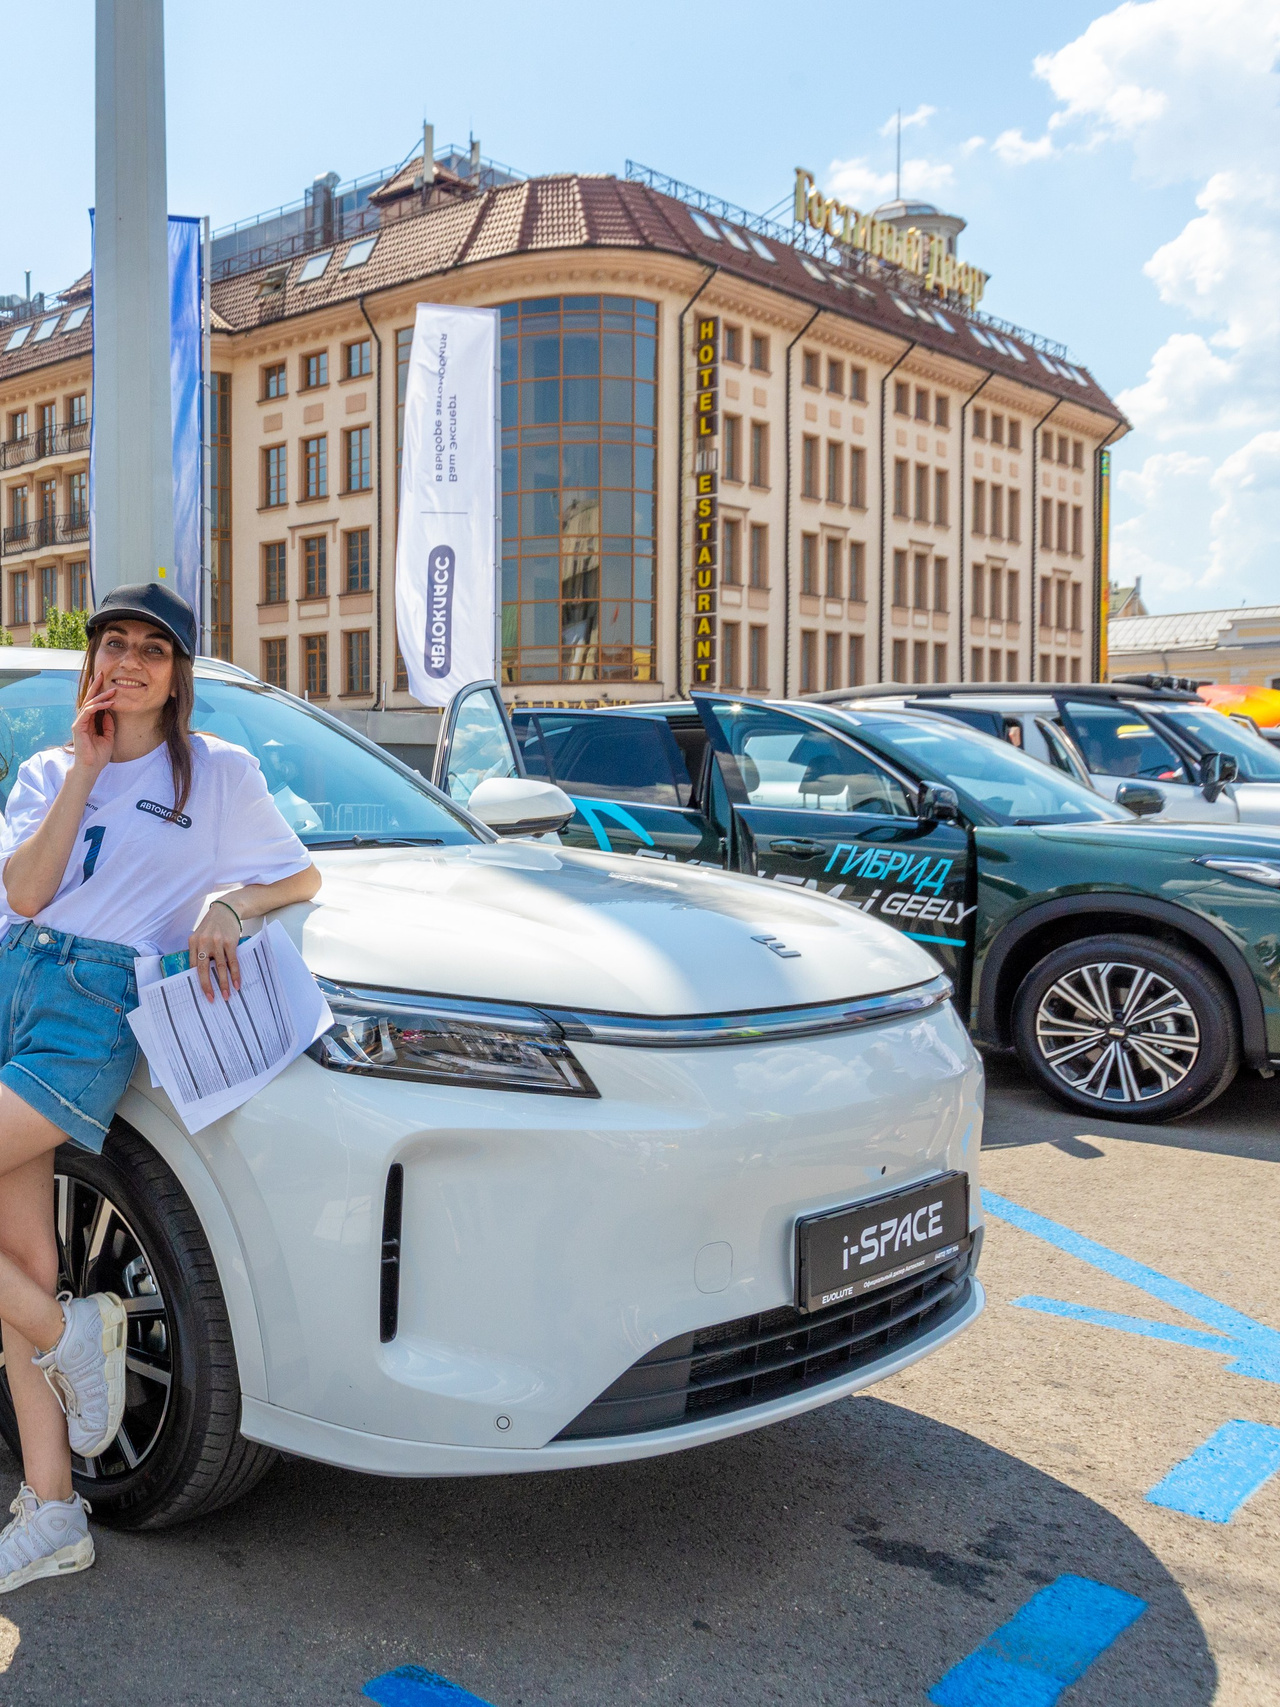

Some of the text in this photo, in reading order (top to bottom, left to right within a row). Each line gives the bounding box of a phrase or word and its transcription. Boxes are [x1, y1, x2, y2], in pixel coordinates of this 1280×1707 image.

[699, 320, 715, 436] HOTEL
[824, 843, 954, 896] ГИБРИД
[880, 891, 978, 925] GEELY
[842, 1200, 943, 1270] i-SPACE
[822, 1287, 854, 1305] EVOLUTE
